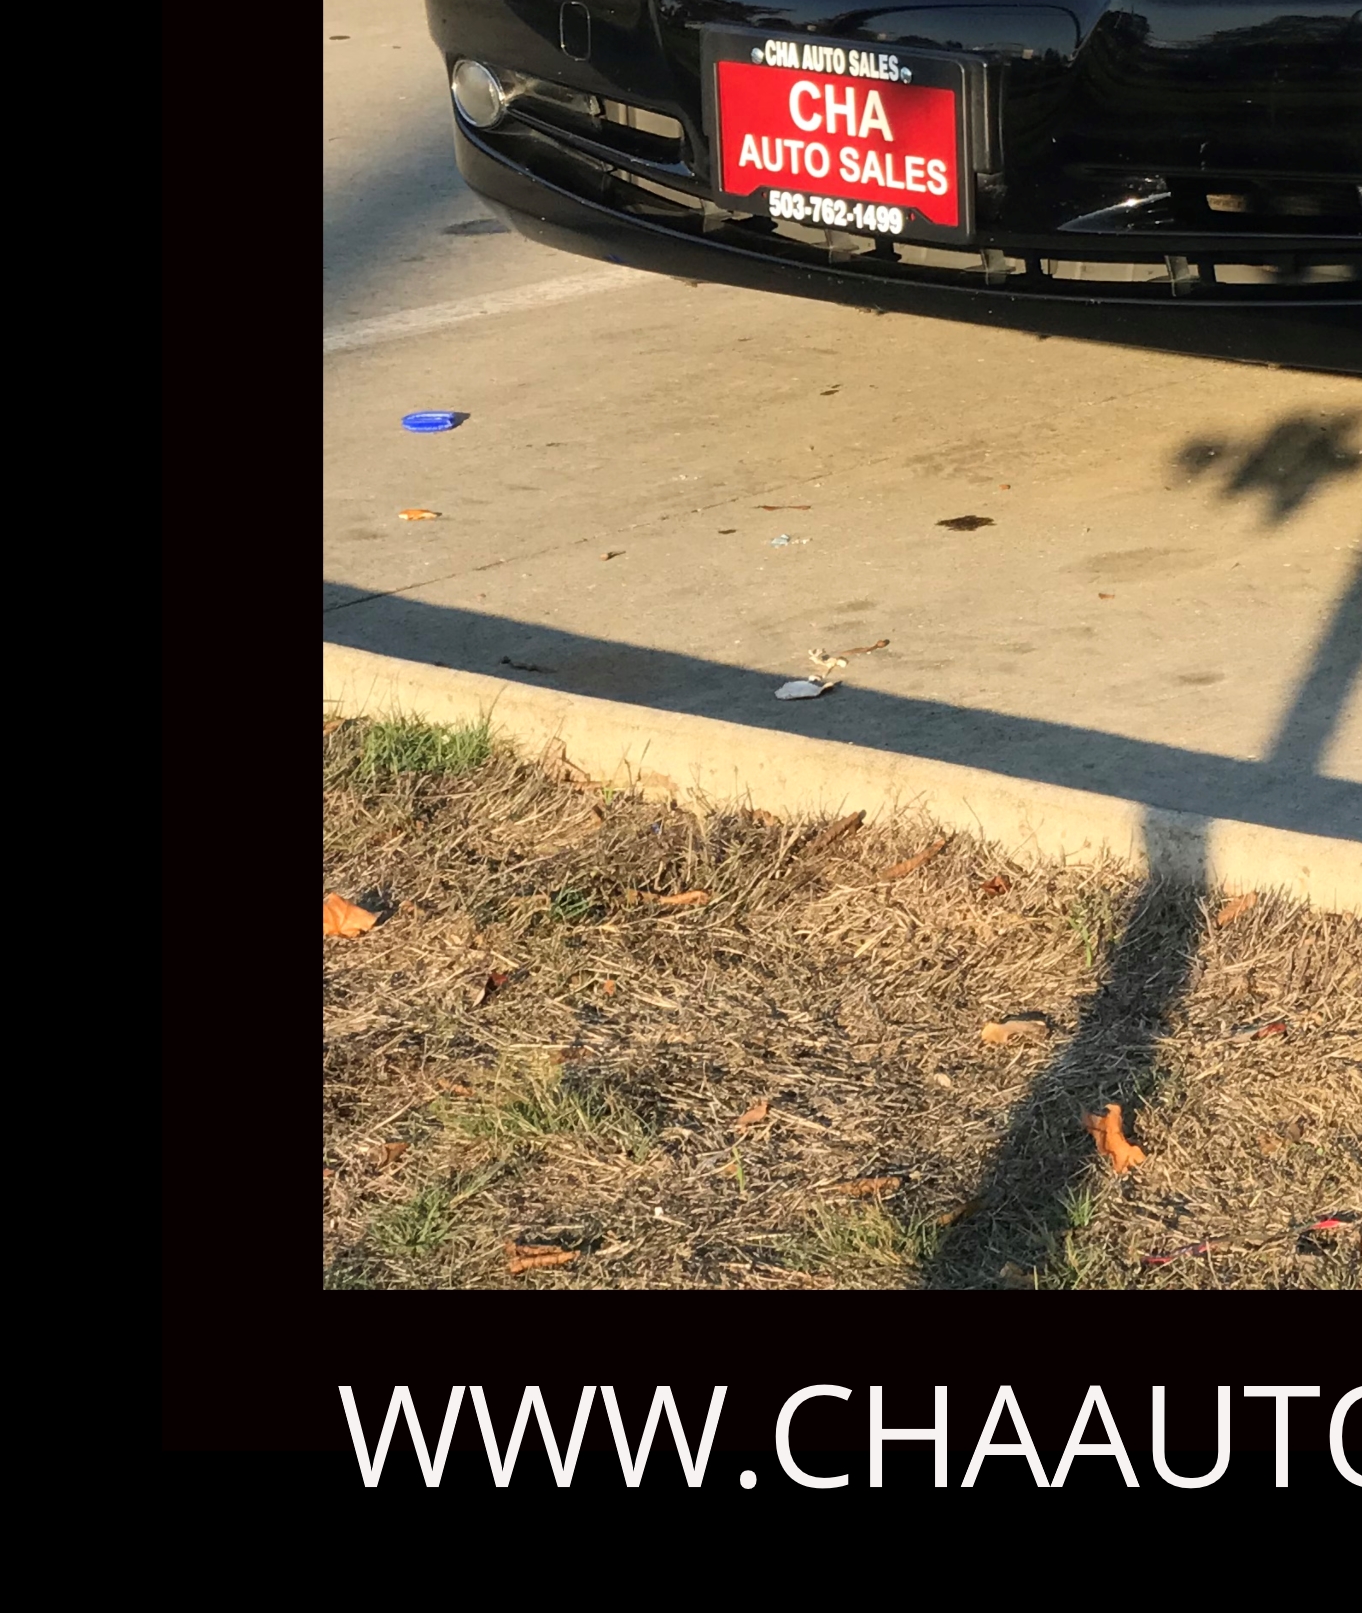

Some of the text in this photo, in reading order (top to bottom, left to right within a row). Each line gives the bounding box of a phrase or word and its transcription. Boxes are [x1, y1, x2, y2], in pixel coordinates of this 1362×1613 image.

[765, 39, 900, 81] CHA AUTO SALES
[789, 80, 893, 142] CHA
[739, 134, 948, 195] AUTO SALES
[769, 190, 902, 234] 503-762-1499
